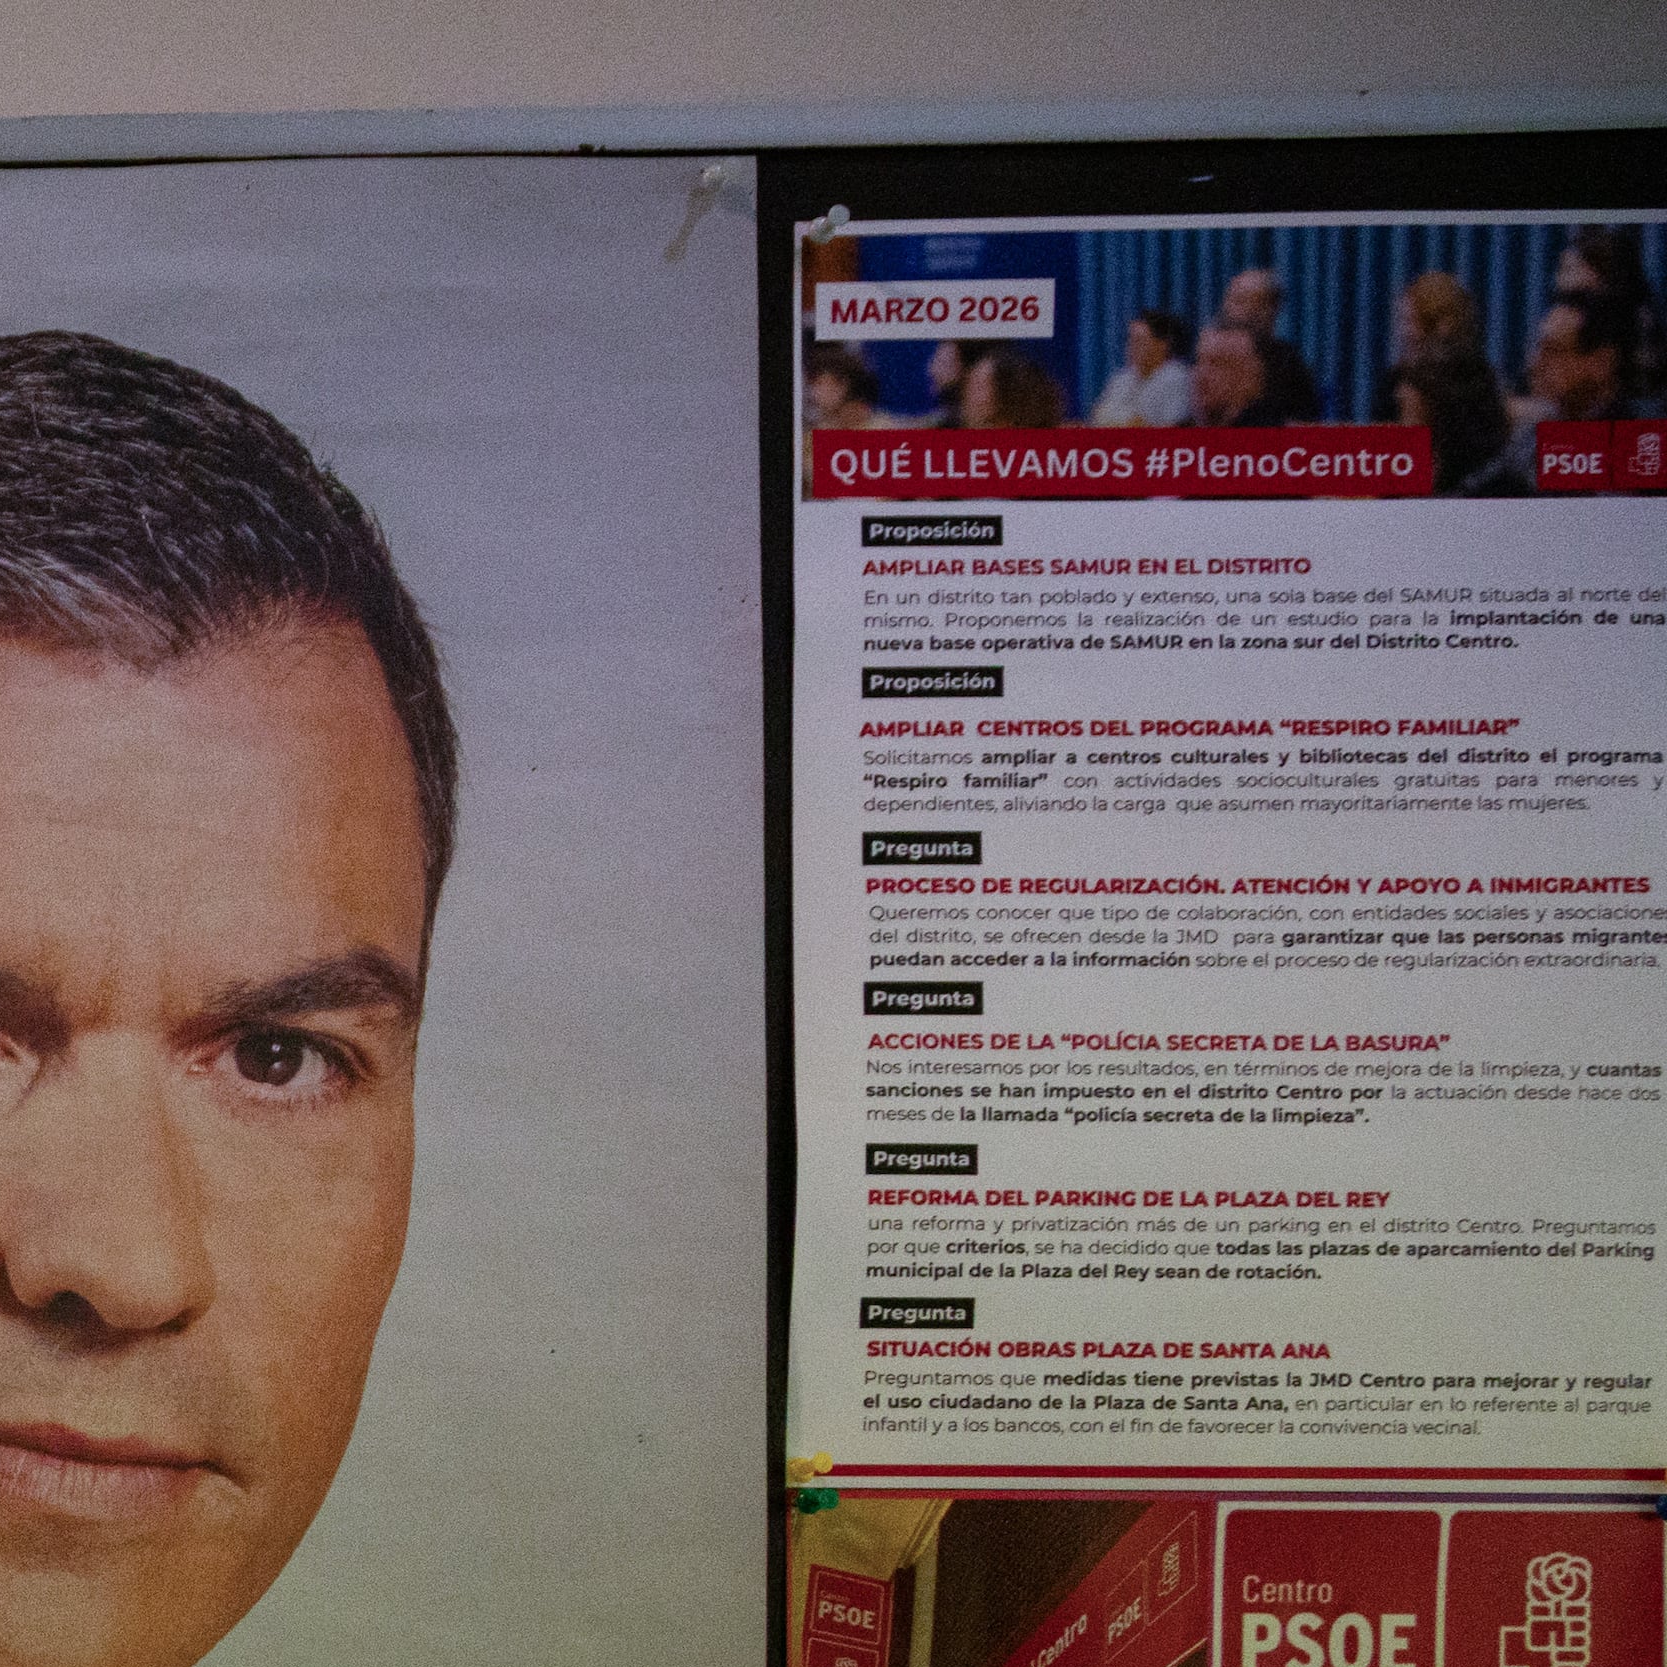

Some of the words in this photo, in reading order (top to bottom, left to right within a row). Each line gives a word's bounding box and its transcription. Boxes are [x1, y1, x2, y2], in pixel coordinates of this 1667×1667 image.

[831, 297, 949, 323] MARZO
[959, 296, 1039, 322] 2026
[831, 443, 911, 485] QUÉ
[924, 448, 1133, 479] LLEVAMOS
[1146, 447, 1413, 477] #PlenoCentro
[1543, 453, 1601, 474] PSOE
[870, 521, 994, 542] Proposición
[862, 559, 964, 576] AMPLIAR
[972, 559, 1044, 575] BASES
[1050, 559, 1130, 575] SAMUR
[1138, 559, 1167, 574] EN
[1175, 558, 1201, 575] EL
[1208, 558, 1311, 574] DISTRITO
[864, 639, 923, 651] nueva
[929, 636, 976, 651] base
[981, 634, 1074, 653] operativa
[1080, 635, 1105, 650] de
[1110, 635, 1183, 650] SAMUR
[1188, 638, 1213, 649] en
[1219, 634, 1236, 649] la
[1242, 637, 1288, 649] zona
[1293, 637, 1324, 649] sur
[1330, 634, 1360, 649] del
[1366, 633, 1440, 649] Distrito
[1445, 634, 1518, 649] Centro.
[871, 840, 973, 860] Pregunta
[867, 1339, 991, 1357] SITUACIÓN
[998, 1342, 1076, 1358] OBRAS
[1083, 1342, 1156, 1358] PLAZA
[1163, 1343, 1193, 1358] DE
[1200, 1342, 1275, 1358] SANTA
[1282, 1343, 1330, 1359] ANA
[1242, 1574, 1333, 1604] Centro
[818, 1600, 876, 1630] PSOE
[1107, 1597, 1142, 1644] PSOE
